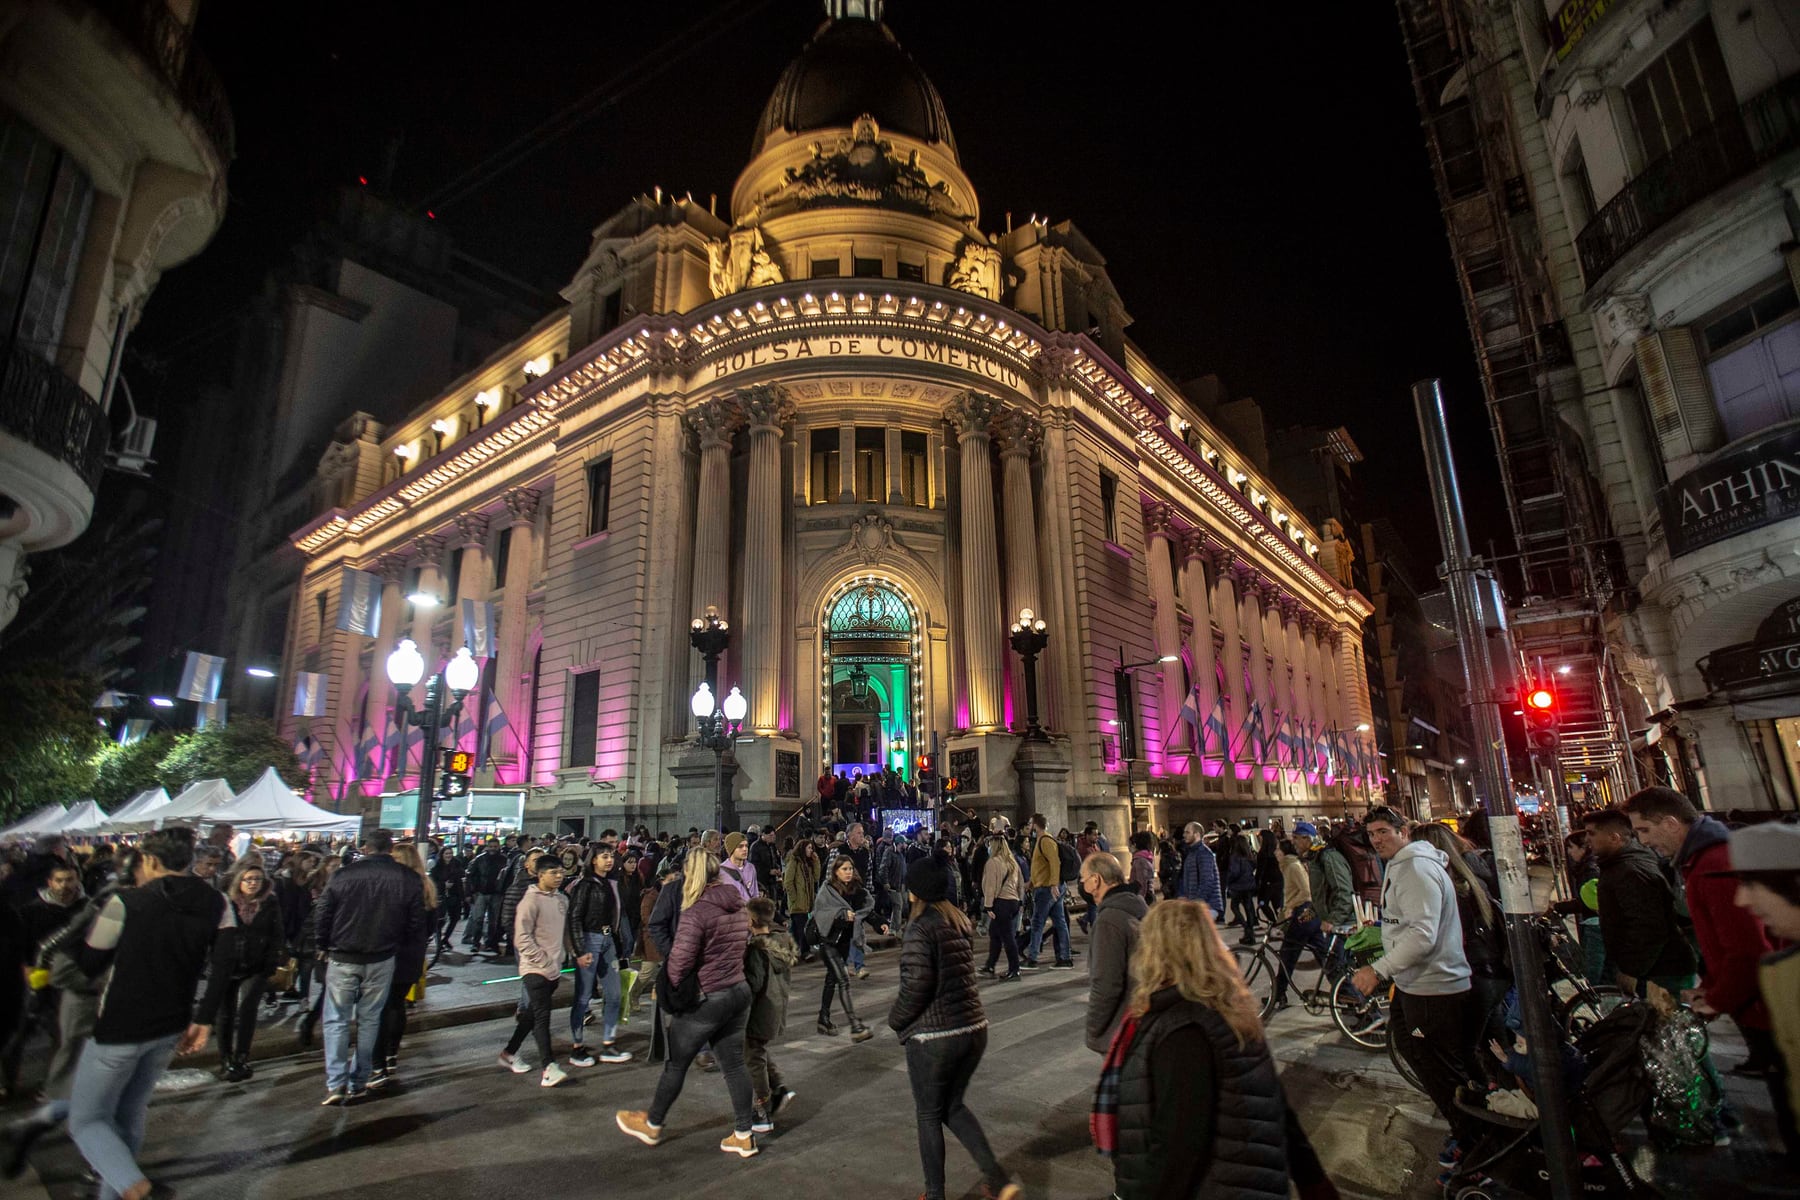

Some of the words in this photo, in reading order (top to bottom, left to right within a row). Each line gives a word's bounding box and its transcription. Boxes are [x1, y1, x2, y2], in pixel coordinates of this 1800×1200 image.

[714, 338, 815, 379] BOLSA
[829, 340, 861, 355] DE
[876, 336, 1020, 389] COMERCIO
